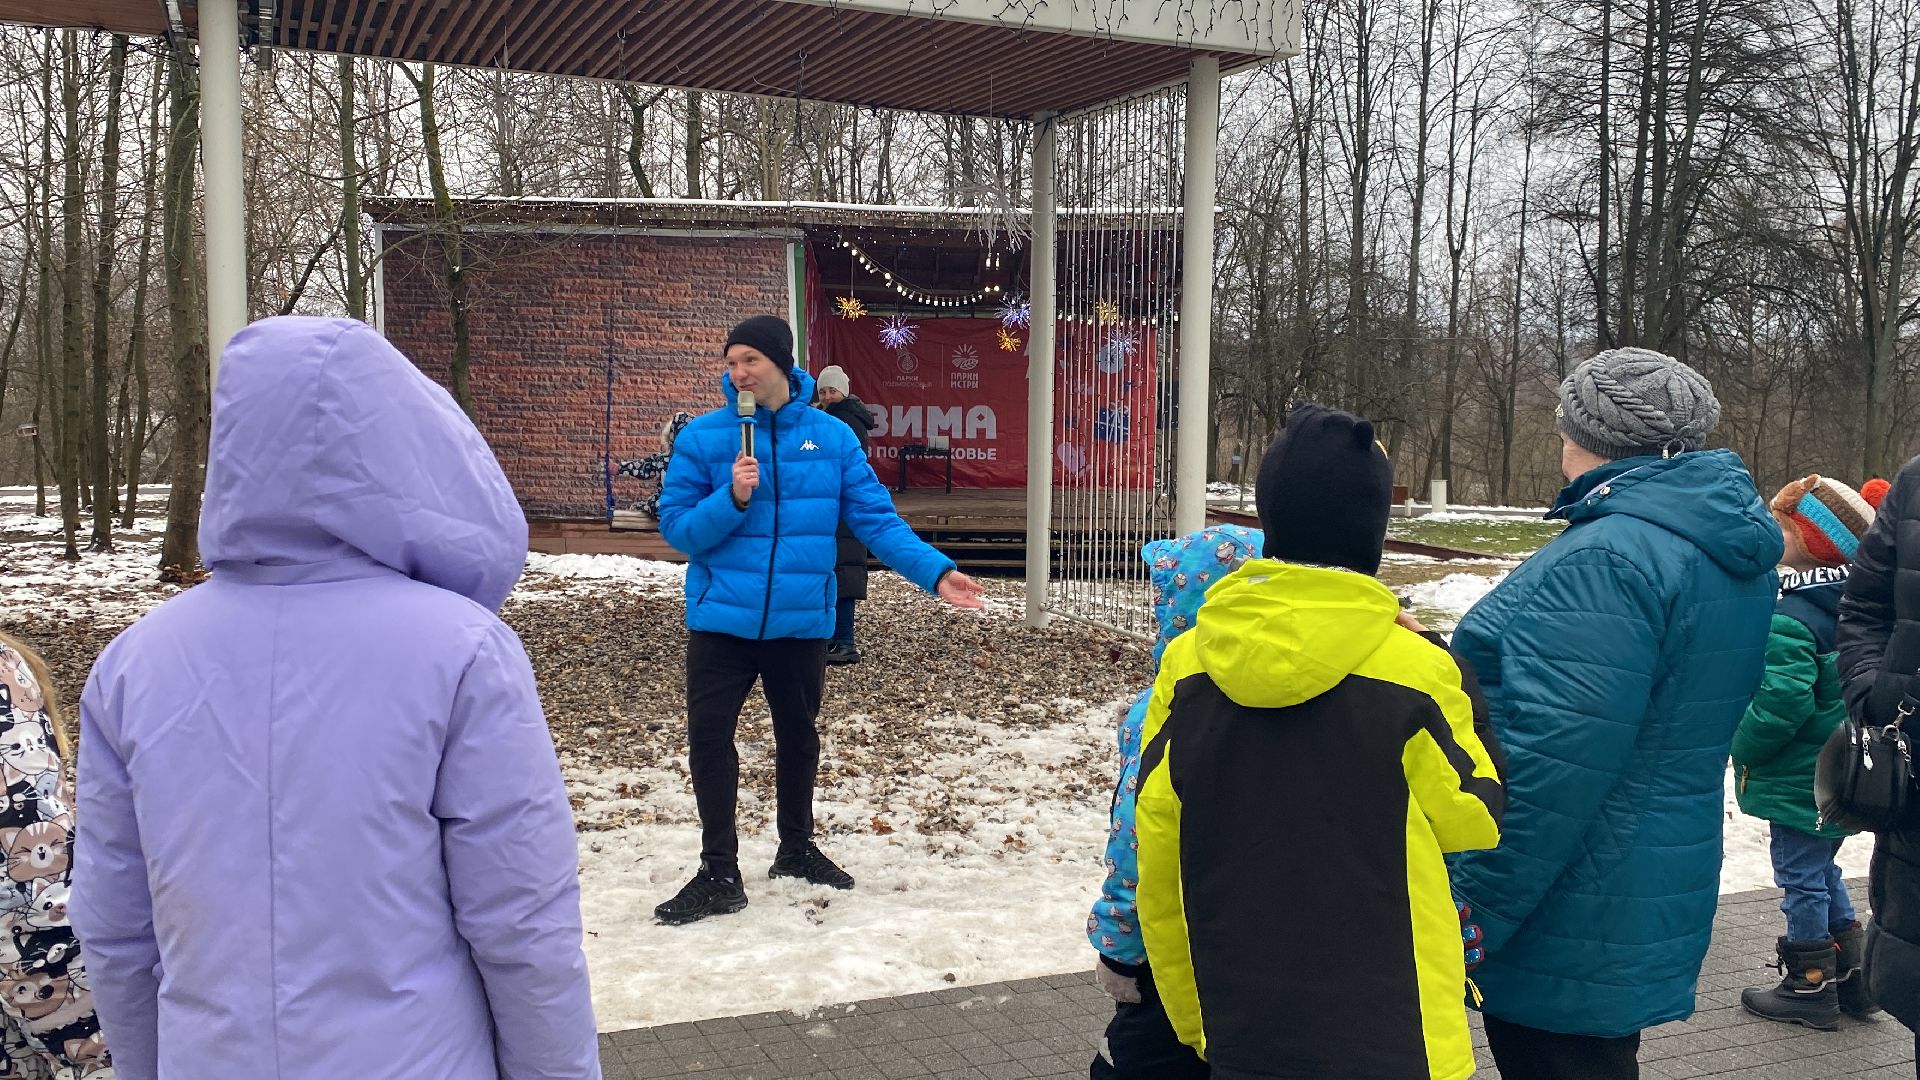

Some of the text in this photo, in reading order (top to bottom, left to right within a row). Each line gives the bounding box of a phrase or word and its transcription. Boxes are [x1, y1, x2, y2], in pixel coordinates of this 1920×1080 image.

[951, 372, 979, 380] ПАРКИ
[951, 381, 979, 389] ИСТРЫ
[863, 403, 997, 439] ЗИМА
